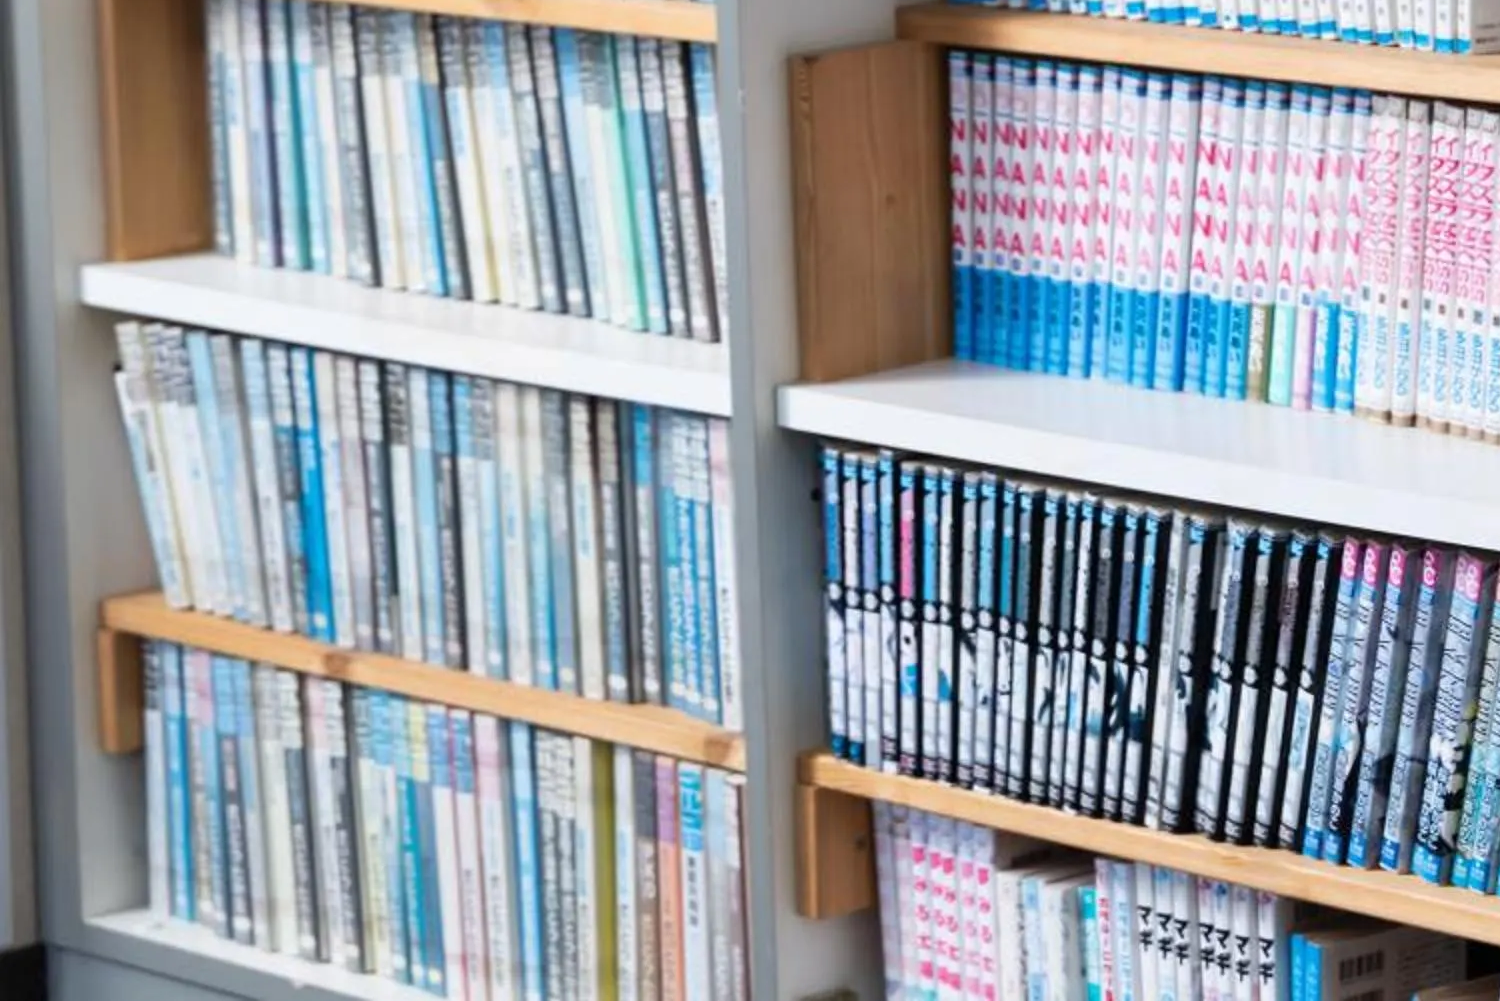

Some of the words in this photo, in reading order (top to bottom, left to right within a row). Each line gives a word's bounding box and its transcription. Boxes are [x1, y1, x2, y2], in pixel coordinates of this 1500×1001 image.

[951, 119, 966, 246] NANA
[973, 120, 987, 249] NANA
[1011, 126, 1027, 255] NANA
[1030, 125, 1049, 254] NANA
[1050, 130, 1069, 259] NANA
[1071, 131, 1092, 262] NANA
[1095, 128, 1113, 259] NANA
[1115, 134, 1134, 267] NANA
[1162, 141, 1185, 272] NANA
[1192, 141, 1217, 275] NANA
[1211, 147, 1233, 278] NANA
[1279, 151, 1303, 286] NANA
[1301, 157, 1324, 290] NANA
[1342, 157, 1365, 291] NANA
[1136, 905, 1153, 951] マギ
[1156, 913, 1173, 959] マギ
[1174, 919, 1190, 965] マギ
[1198, 922, 1215, 969] マギ
[1216, 929, 1231, 975] マギ
[1236, 935, 1251, 982] マギ
[1259, 938, 1275, 984] マギ
